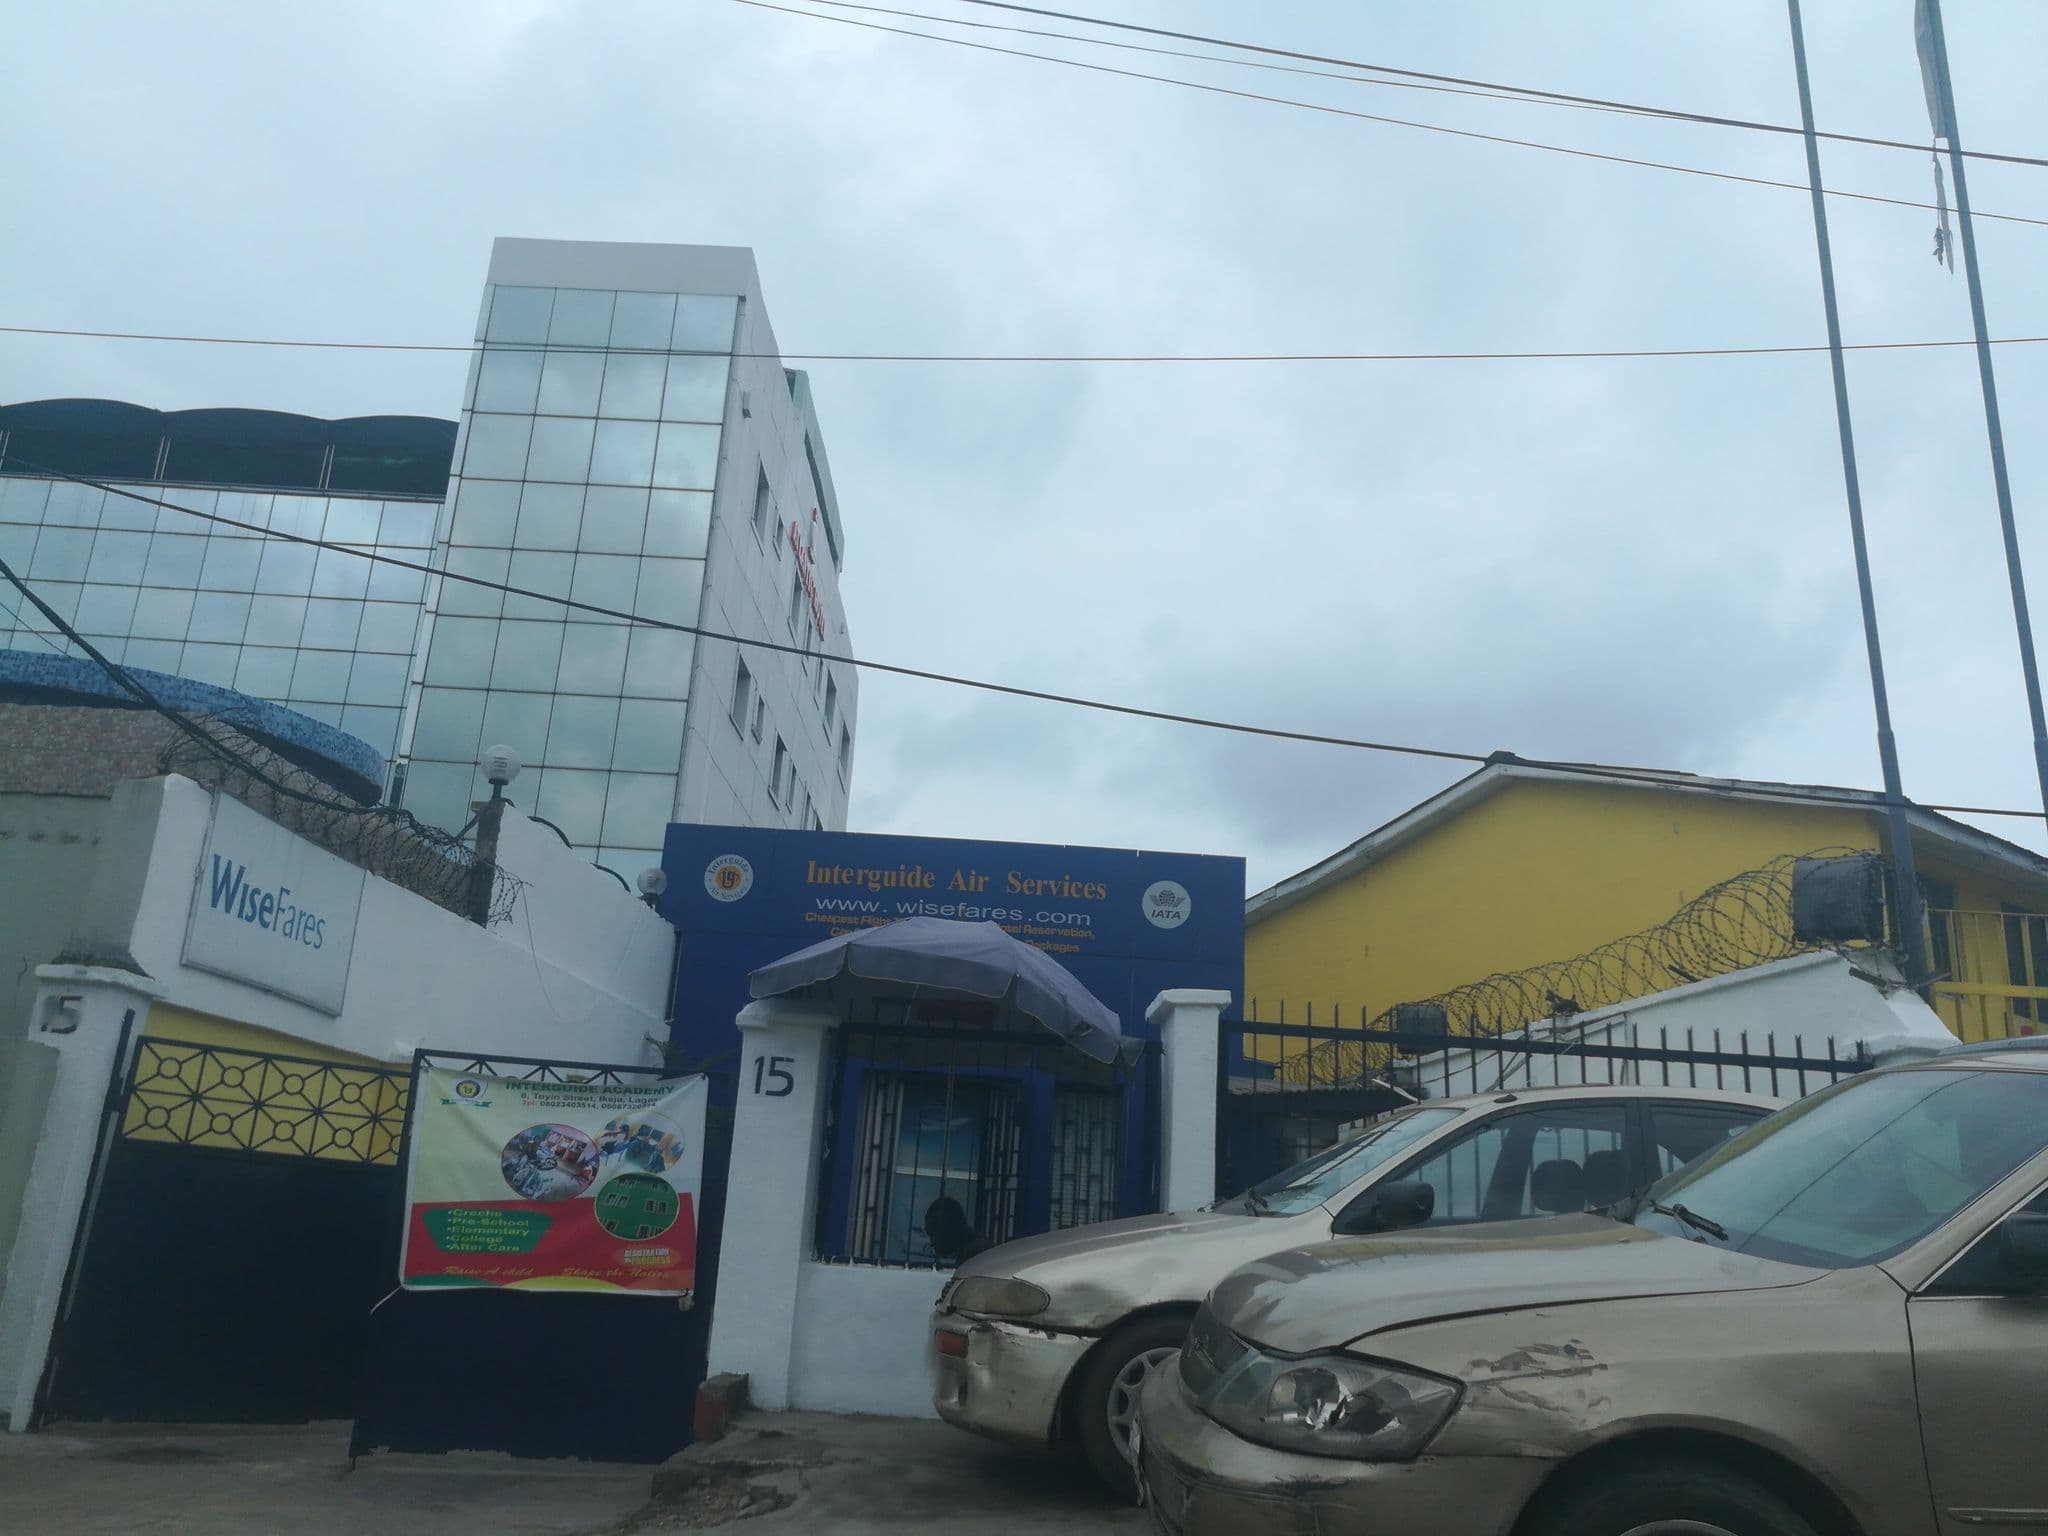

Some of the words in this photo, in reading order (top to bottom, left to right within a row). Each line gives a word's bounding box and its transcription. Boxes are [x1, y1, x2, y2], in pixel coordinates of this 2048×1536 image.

[806, 860, 936, 891] Interguide
[946, 868, 991, 892] Air
[1006, 870, 1108, 900] Services
[1151, 909, 1182, 920] IATA
[505, 1082, 599, 1094] INTERGUIDE
[602, 1085, 676, 1096] ACADEMY
[754, 1055, 795, 1097] 15
